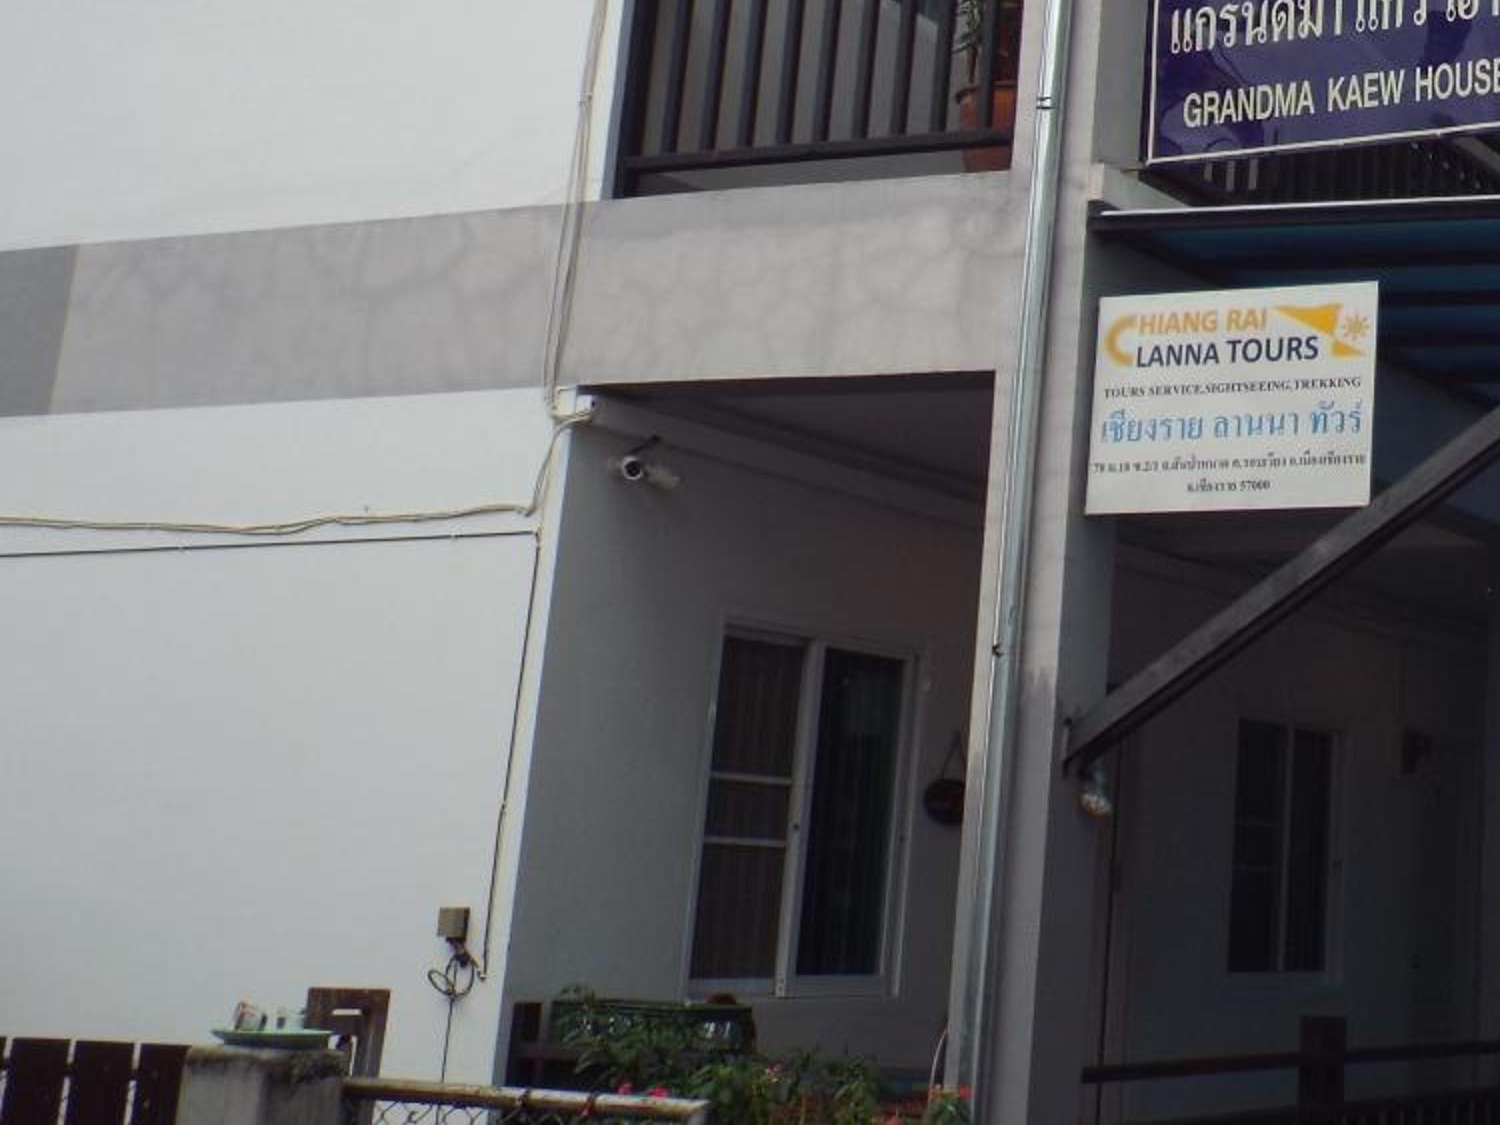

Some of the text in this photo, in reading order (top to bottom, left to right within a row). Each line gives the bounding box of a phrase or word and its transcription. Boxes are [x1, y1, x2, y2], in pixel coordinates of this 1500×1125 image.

[1183, 82, 1315, 128] GRANDMA
[1327, 69, 1404, 112] KAEW
[1104, 307, 1267, 367] CHIANG RAI
[1136, 336, 1319, 368] LANNA TOURS
[1104, 386, 1145, 399] TOURS
[1102, 409, 1204, 443] เชียงราย
[1311, 399, 1363, 434] ทัวร์
[1239, 479, 1271, 491] 57000
